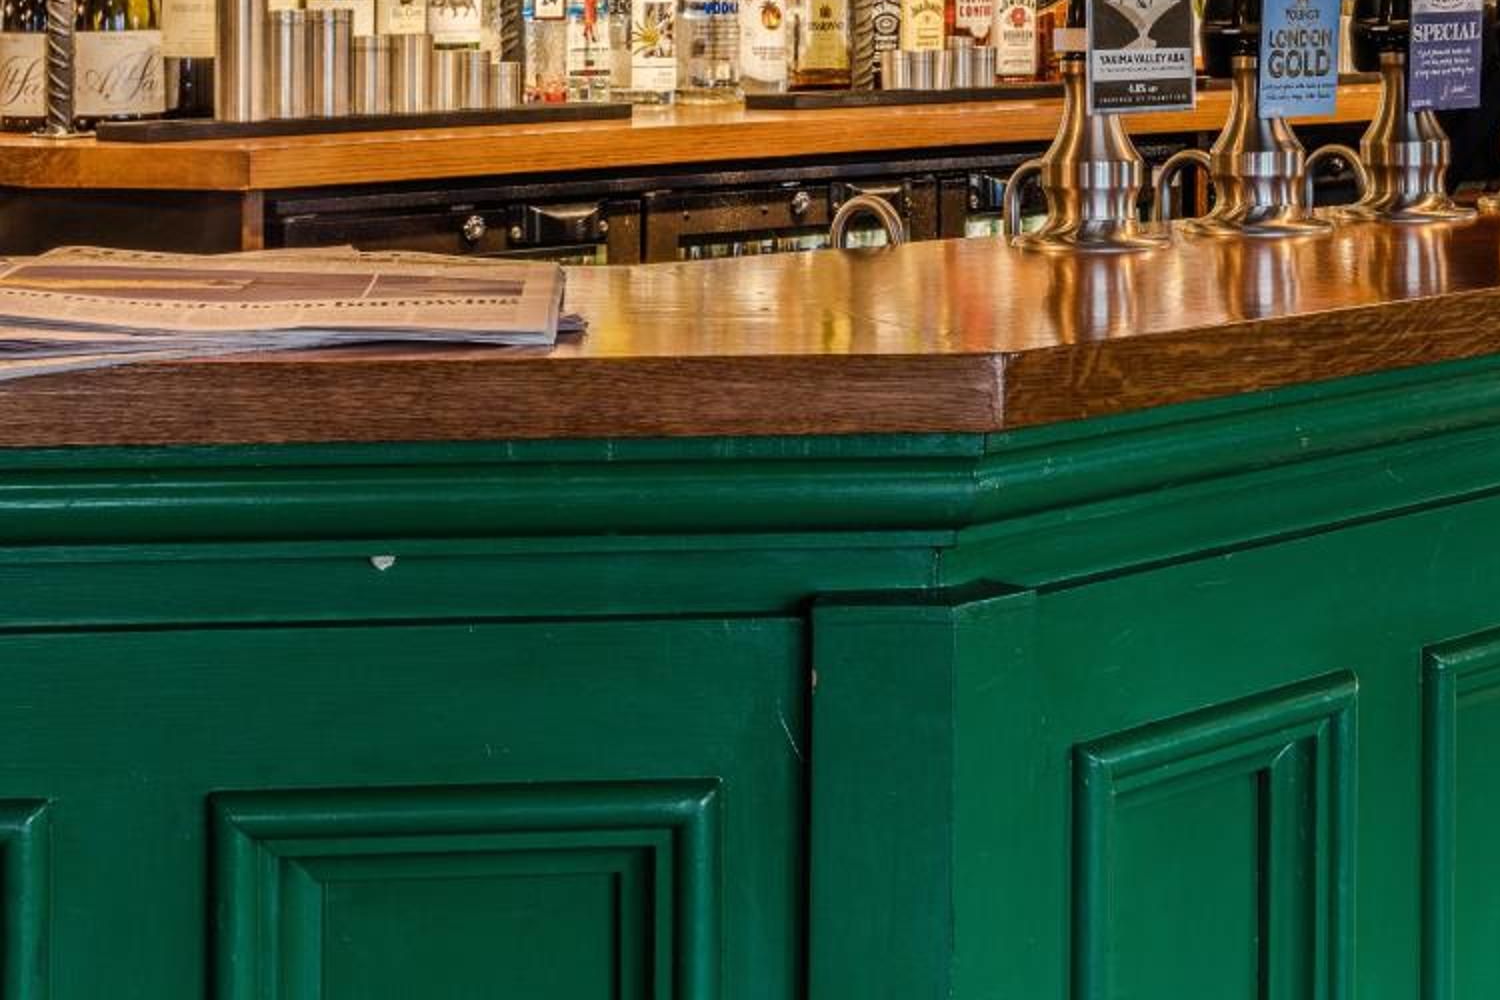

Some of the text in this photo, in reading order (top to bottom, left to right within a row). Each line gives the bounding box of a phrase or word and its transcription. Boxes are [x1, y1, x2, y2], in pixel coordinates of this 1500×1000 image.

[1268, 28, 1334, 49] LONDON
[1413, 21, 1481, 43] SPECIAL
[1267, 49, 1331, 79] GOLD
